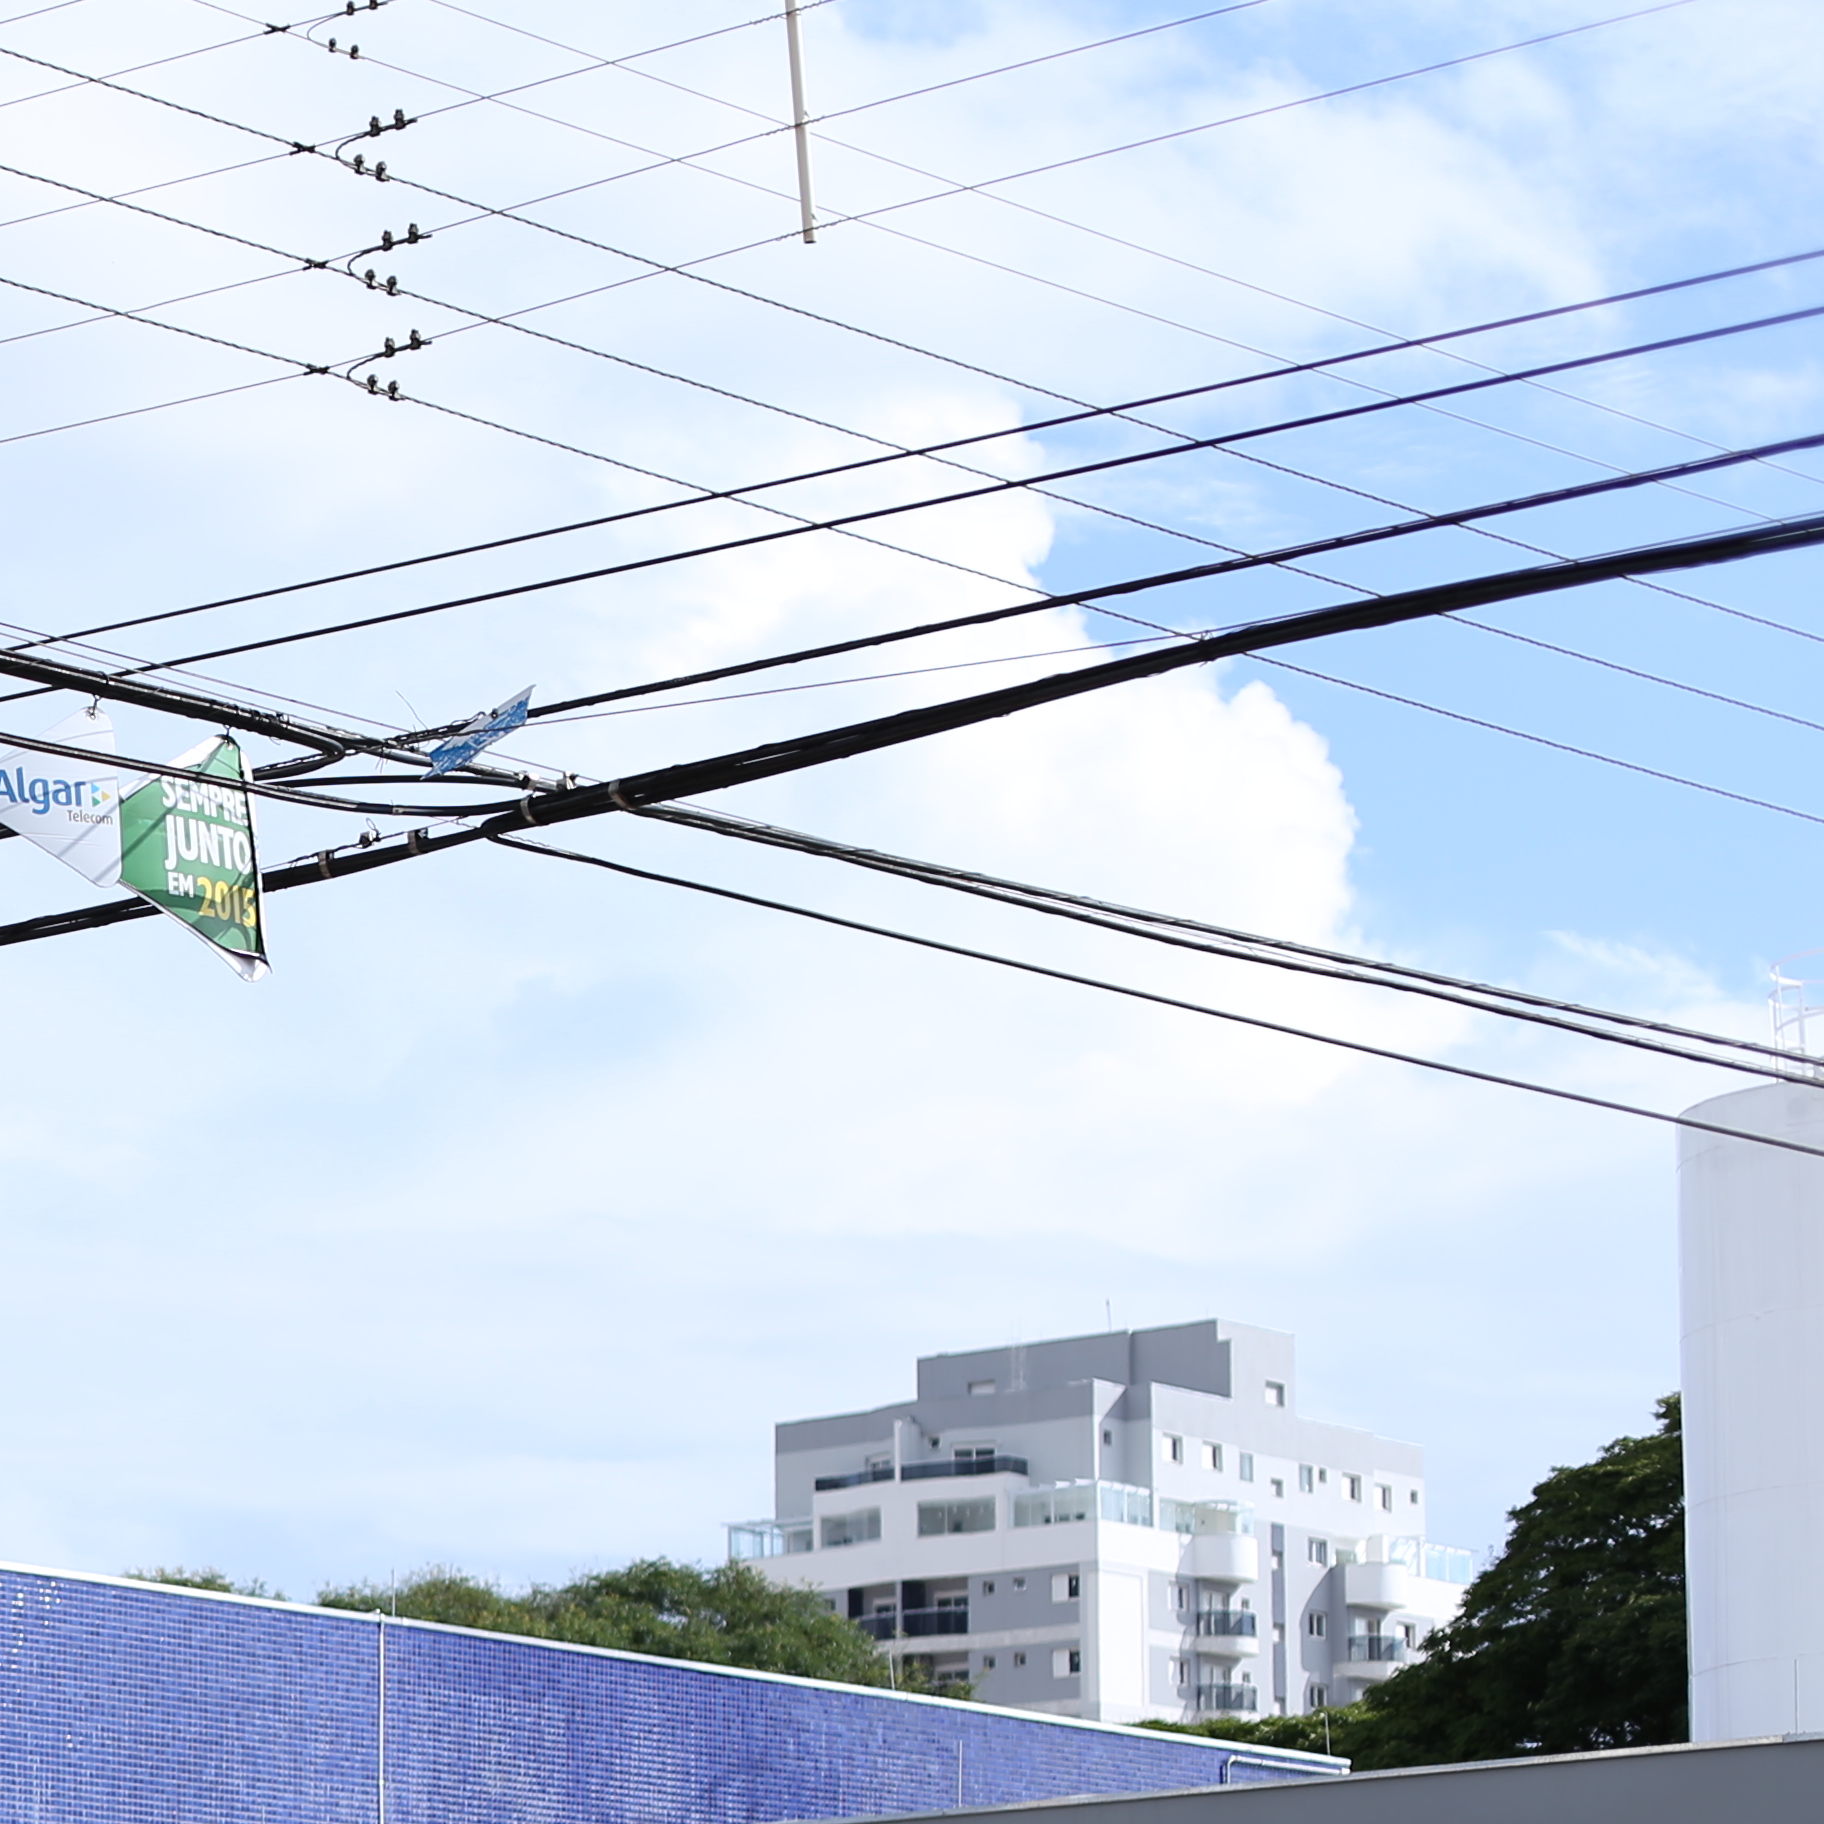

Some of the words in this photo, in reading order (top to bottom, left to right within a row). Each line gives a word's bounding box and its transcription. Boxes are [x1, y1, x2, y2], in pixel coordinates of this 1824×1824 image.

[160, 774, 249, 827] SEMPRE
[66, 809, 114, 825] Telecom
[167, 871, 195, 898] EM
